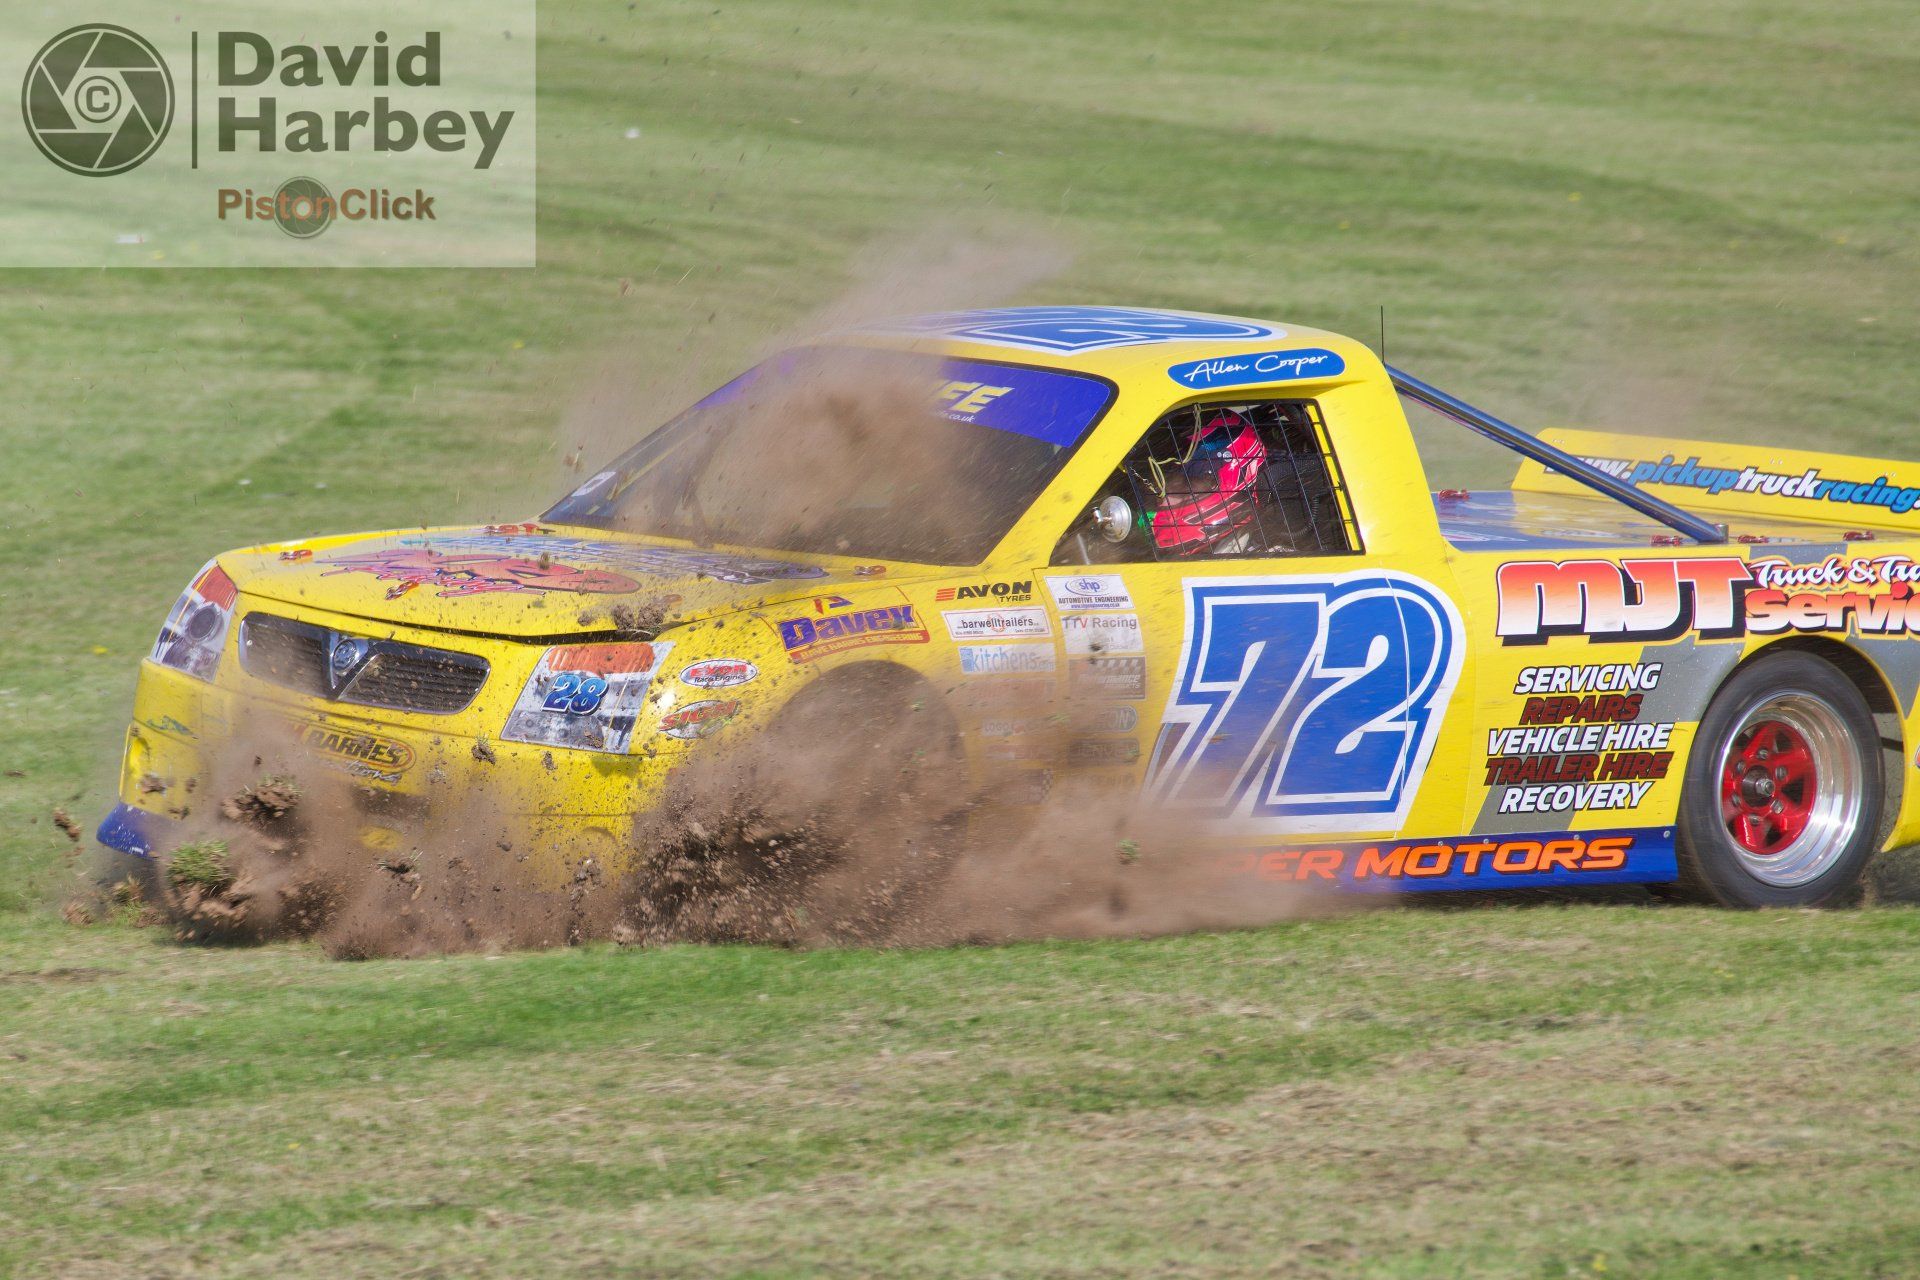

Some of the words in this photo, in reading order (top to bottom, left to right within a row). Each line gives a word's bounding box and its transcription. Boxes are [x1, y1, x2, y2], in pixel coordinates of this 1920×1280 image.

[1183, 361, 1250, 383] Allen
[1255, 354, 1328, 376] Cooper
[1079, 578, 1100, 592] shp
[1749, 557, 1849, 589] Truck
[1846, 557, 1879, 587] &
[956, 580, 1032, 600] AVON
[999, 595, 1032, 603] TYRES
[1496, 556, 1754, 646] MJT
[1062, 616, 1088, 629] TTV
[1092, 617, 1137, 630] Racing
[1513, 662, 1663, 694] SERVICING
[540, 673, 609, 716] 28
[1144, 568, 1467, 833] 72
[1519, 694, 1643, 725] REPAIRS
[1487, 724, 1604, 755] VEHICLE
[1601, 722, 1675, 751] HIRE
[1484, 754, 1600, 785] TRAILER
[1597, 751, 1674, 781] HIRE
[1498, 781, 1655, 814] RECOVERY
[1354, 837, 1634, 880] MOTORS
